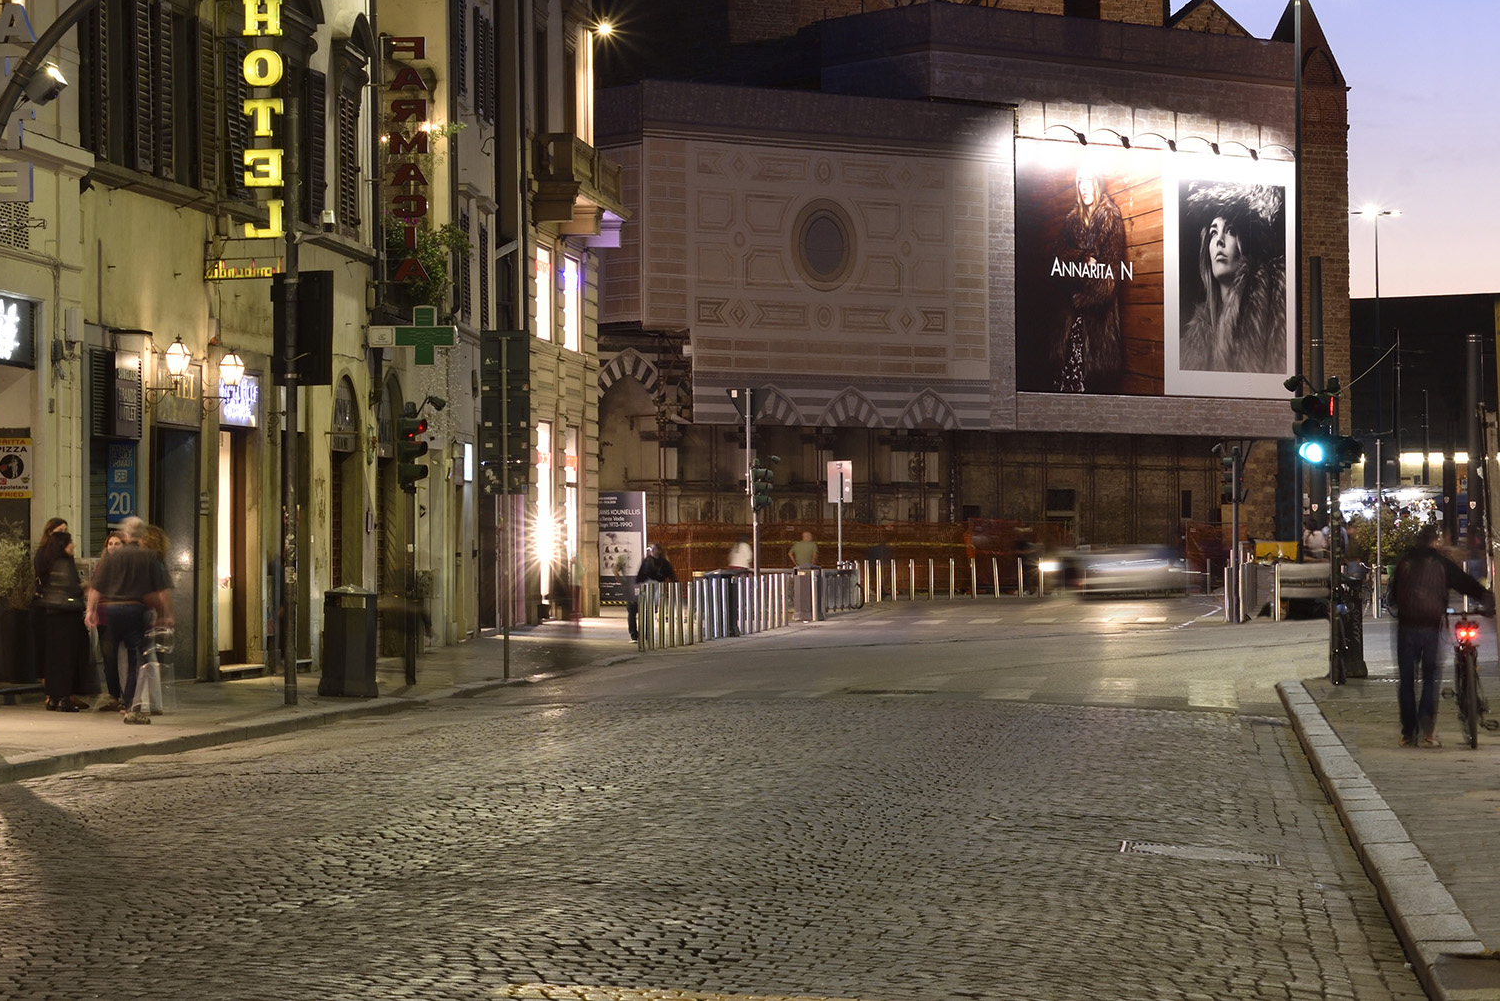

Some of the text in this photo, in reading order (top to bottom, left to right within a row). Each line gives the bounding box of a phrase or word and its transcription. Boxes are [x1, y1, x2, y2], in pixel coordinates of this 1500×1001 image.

[1050, 256, 1133, 281] ANNARITA N
[610, 508, 641, 516] KOUNELLIS
